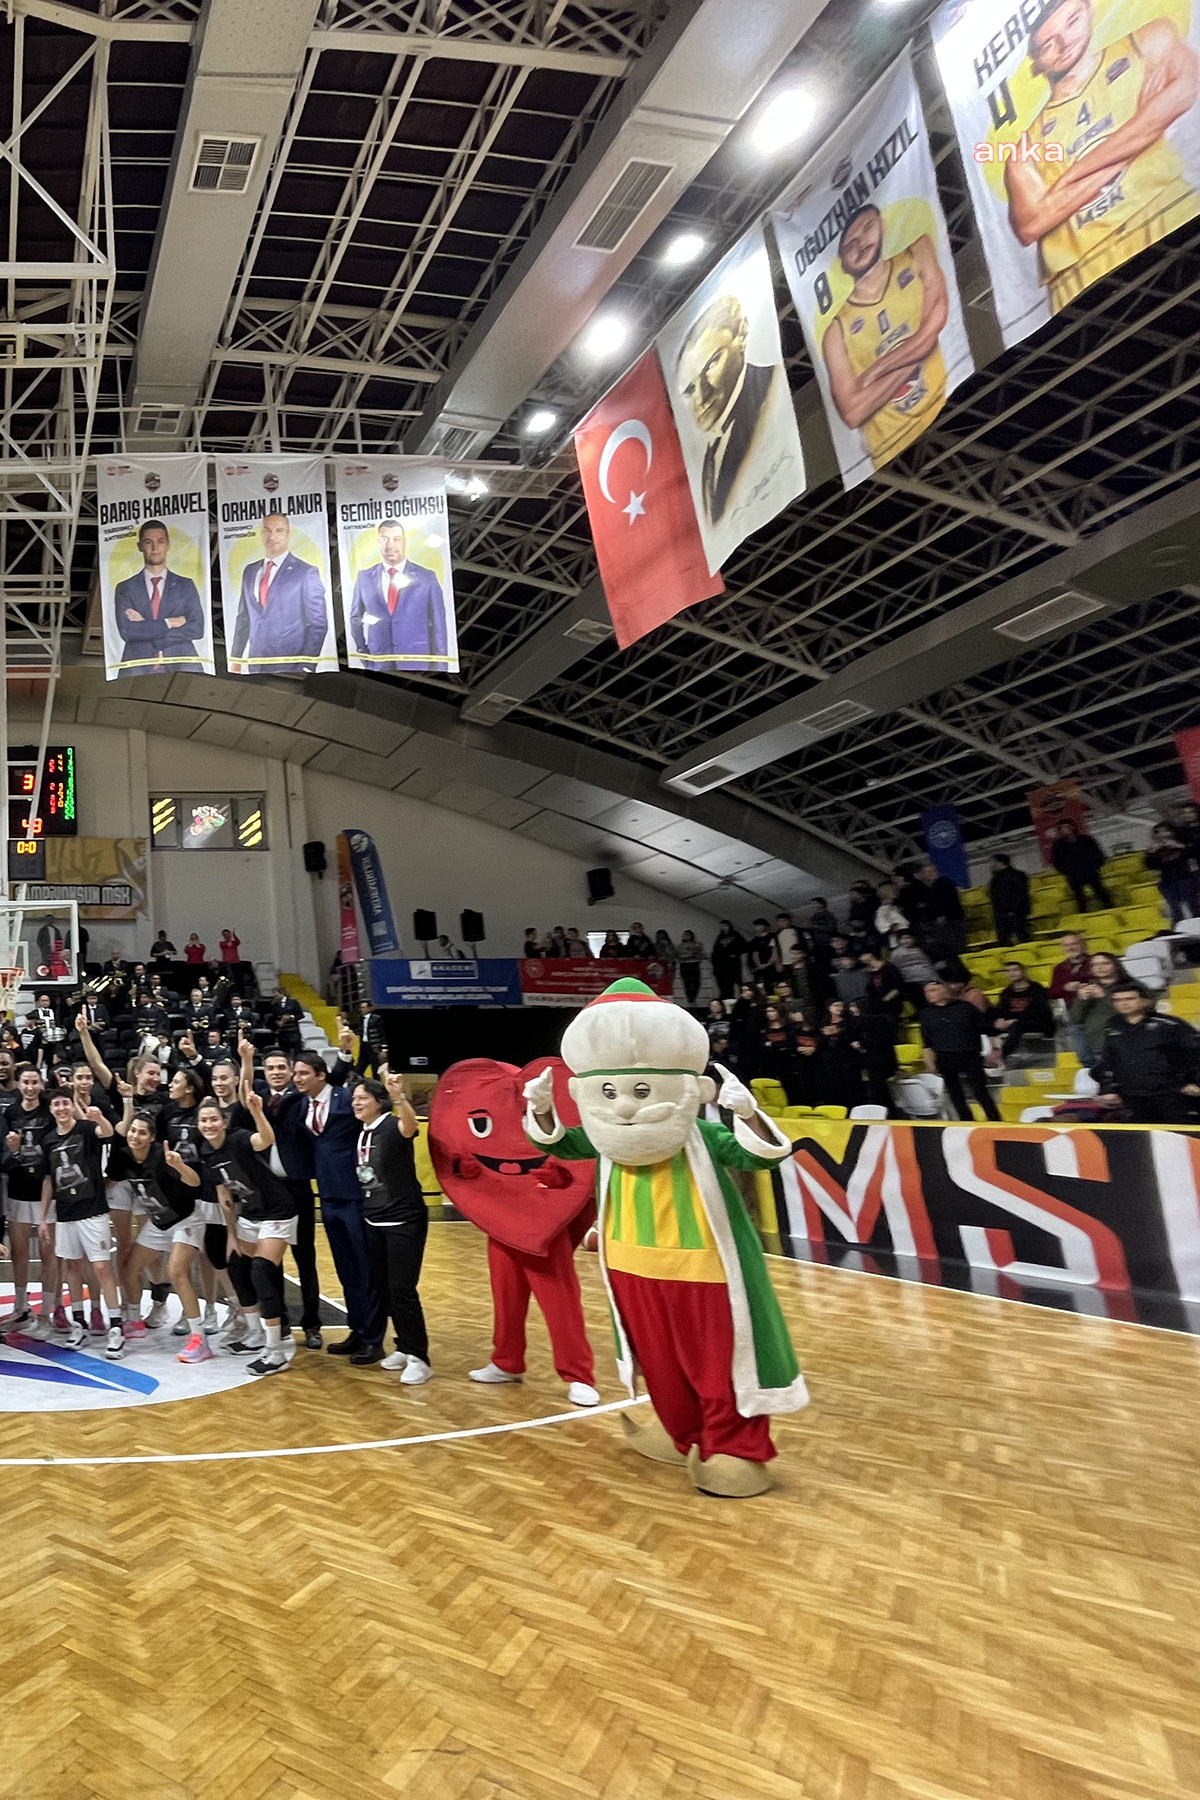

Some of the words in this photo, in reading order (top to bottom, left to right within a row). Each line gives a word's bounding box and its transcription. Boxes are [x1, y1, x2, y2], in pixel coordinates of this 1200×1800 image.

[973, 0, 1048, 89] KERE
[795, 171, 870, 276] OĞUZHAN
[866, 119, 919, 189] KIZIL
[100, 500, 141, 525] BARIŞ
[143, 492, 206, 519] KARAYEL
[222, 499, 267, 523] ORHAN
[269, 493, 323, 517] ALANUR
[341, 498, 383, 523] SEMİH
[384, 495, 445, 518] SOĞUKSU
[23, 774, 35, 791] 3
[192, 805, 223, 819] MSK
[102, 886, 130, 904] MSK
